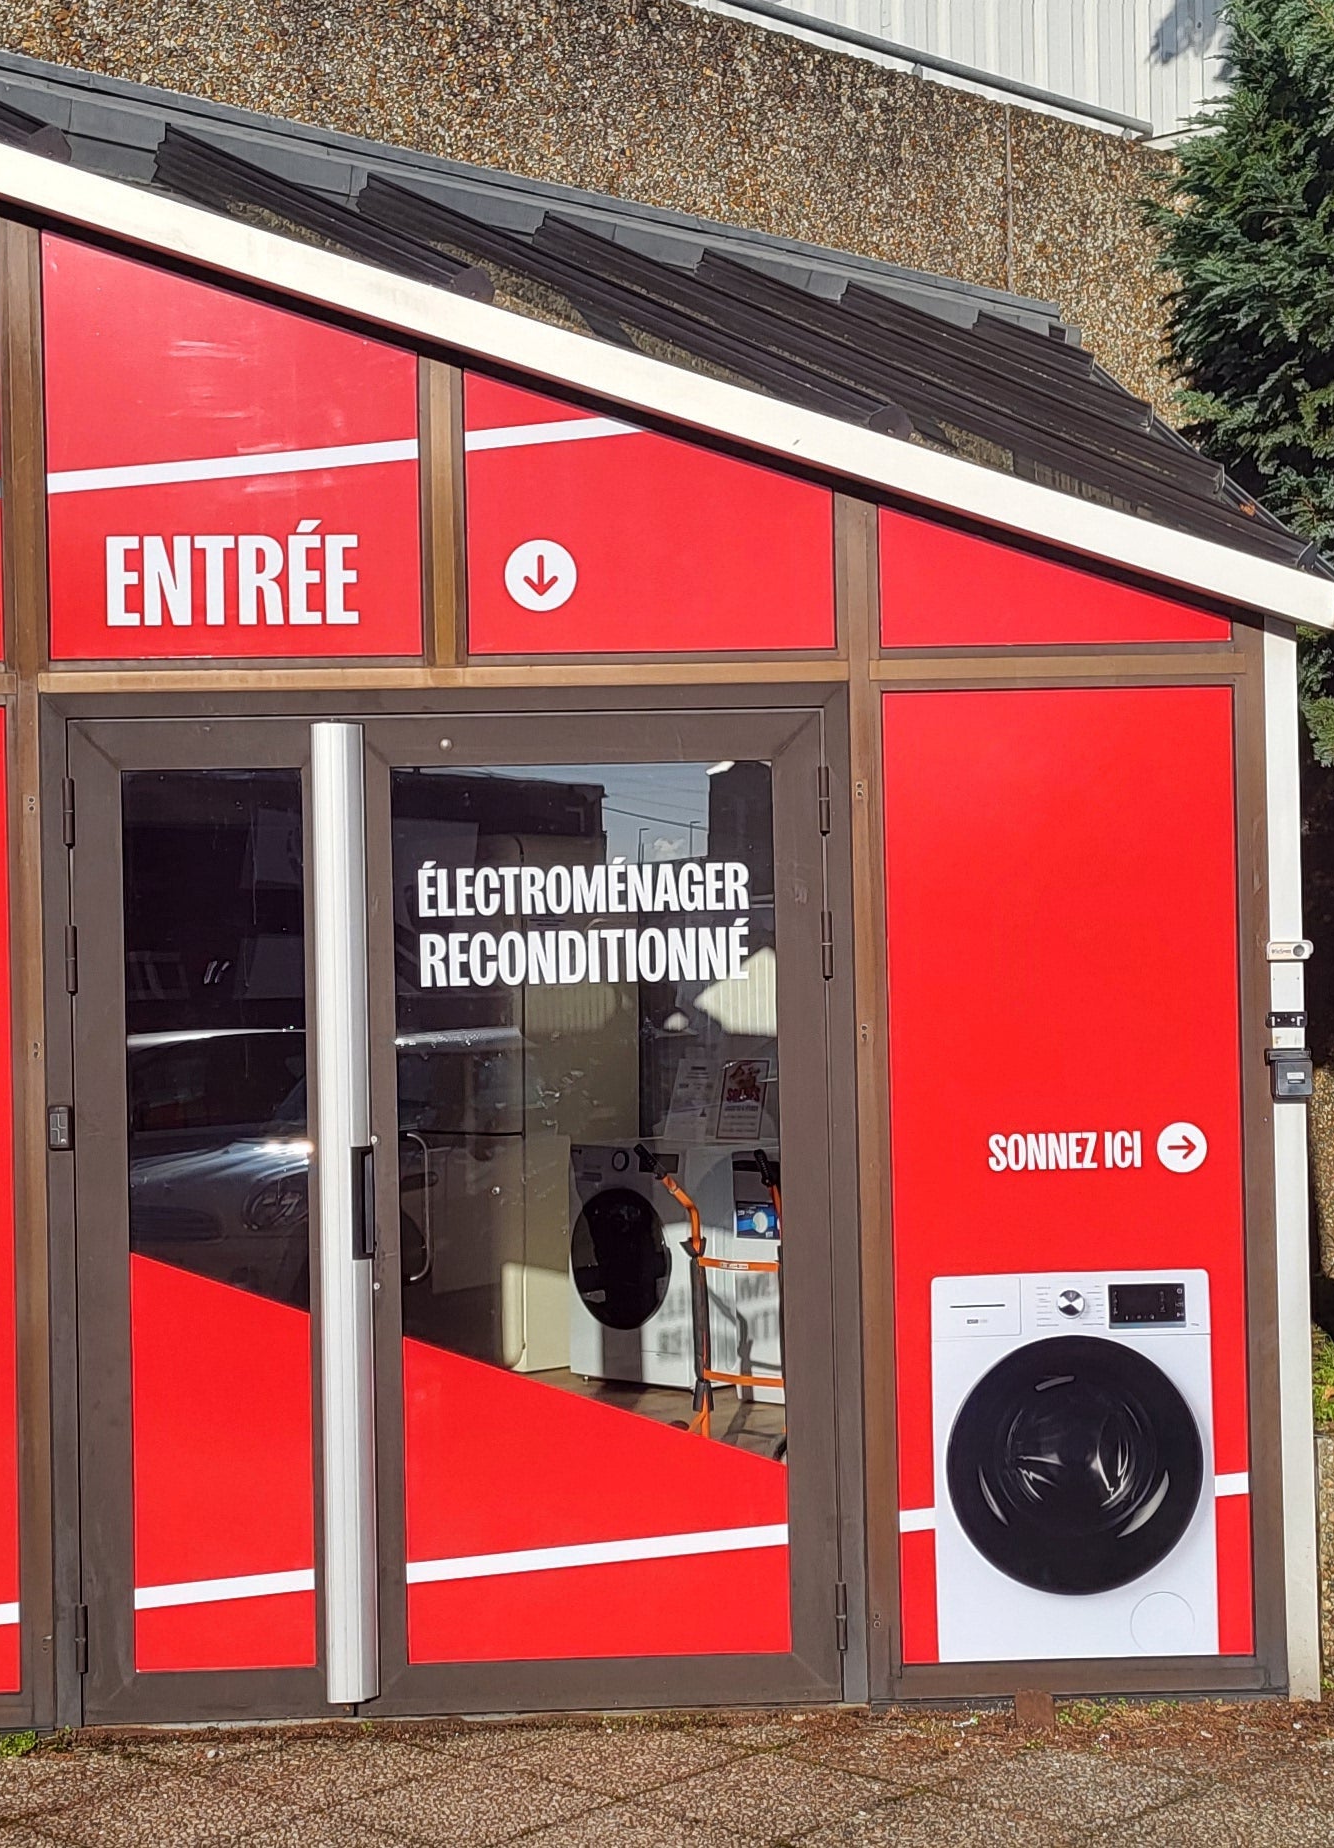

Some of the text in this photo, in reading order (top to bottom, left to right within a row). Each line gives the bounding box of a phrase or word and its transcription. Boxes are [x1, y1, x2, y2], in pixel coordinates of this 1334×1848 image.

[105, 519, 359, 627] ENTRÉE
[418, 856, 750, 918] ÉLECTROMÉNAGER
[419, 918, 749, 988] RECONDITIONNÉ
[988, 1130, 1142, 1172] SONNEZ ICI
